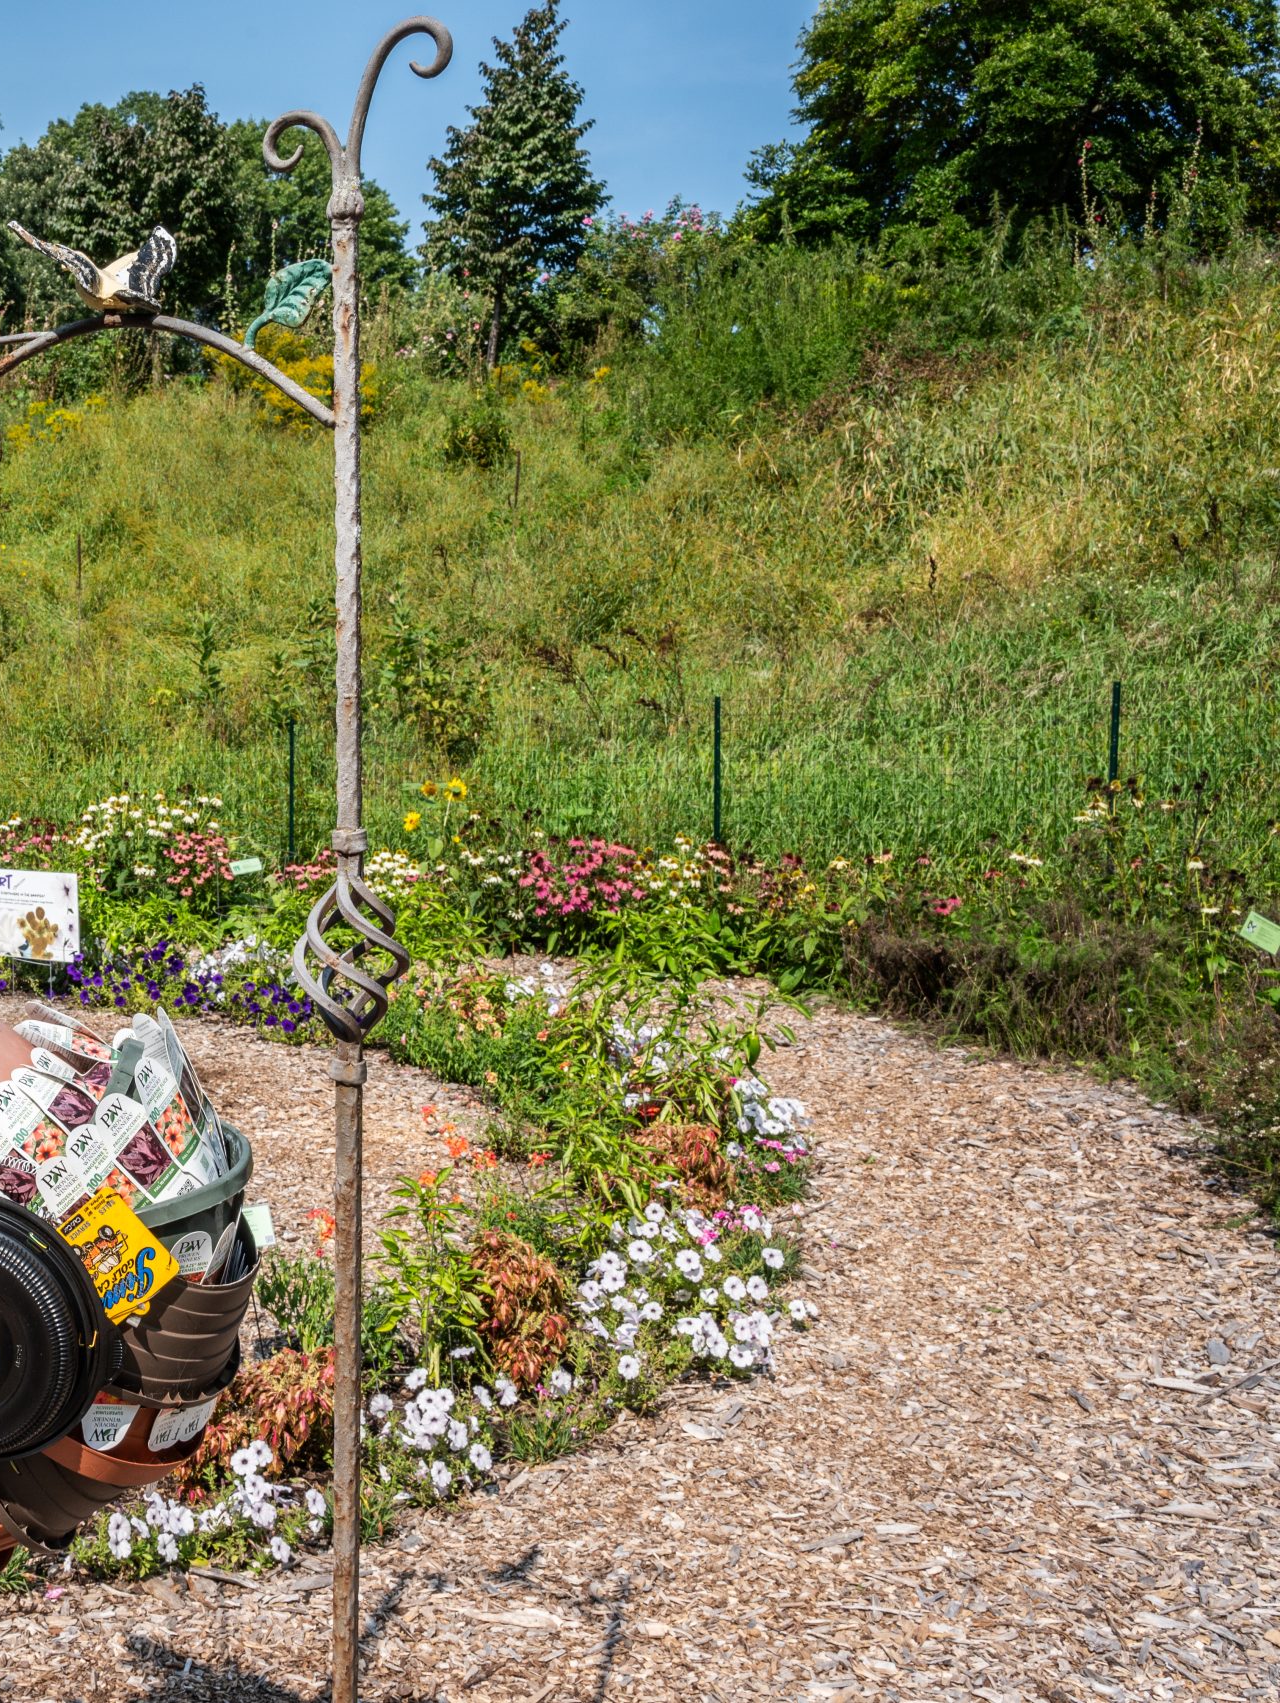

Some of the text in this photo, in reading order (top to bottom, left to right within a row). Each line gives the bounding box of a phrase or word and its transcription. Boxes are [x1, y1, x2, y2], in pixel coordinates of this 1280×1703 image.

[37, 1052, 52, 1071] PW
[137, 1061, 154, 1088] PW
[100, 1098, 124, 1128] PW
[111, 1111, 128, 1132] PROVEN
[149, 1107, 160, 1121] 100
[113, 1111, 133, 1137] WINNERS
[13, 1127, 29, 1144] 100
[71, 1128, 93, 1158] PW
[81, 1140, 99, 1161] PROVEN
[84, 1141, 104, 1166] WINNERS
[83, 1151, 104, 1175] TANGERINE
[41, 1160, 68, 1189] PW
[53, 1173, 73, 1192] PROVEN
[87, 1173, 103, 1190] 100
[55, 1175, 80, 1197] WINNERS
[56, 1192, 71, 1207] PROVEN
[99, 1199, 115, 1215] SALES
[69, 1221, 91, 1240] SERVICE
[180, 1239, 206, 1253] PW
[113, 1258, 135, 1283] GOLF
[97, 1279, 110, 1293] CA
[89, 1428, 118, 1442] PW
